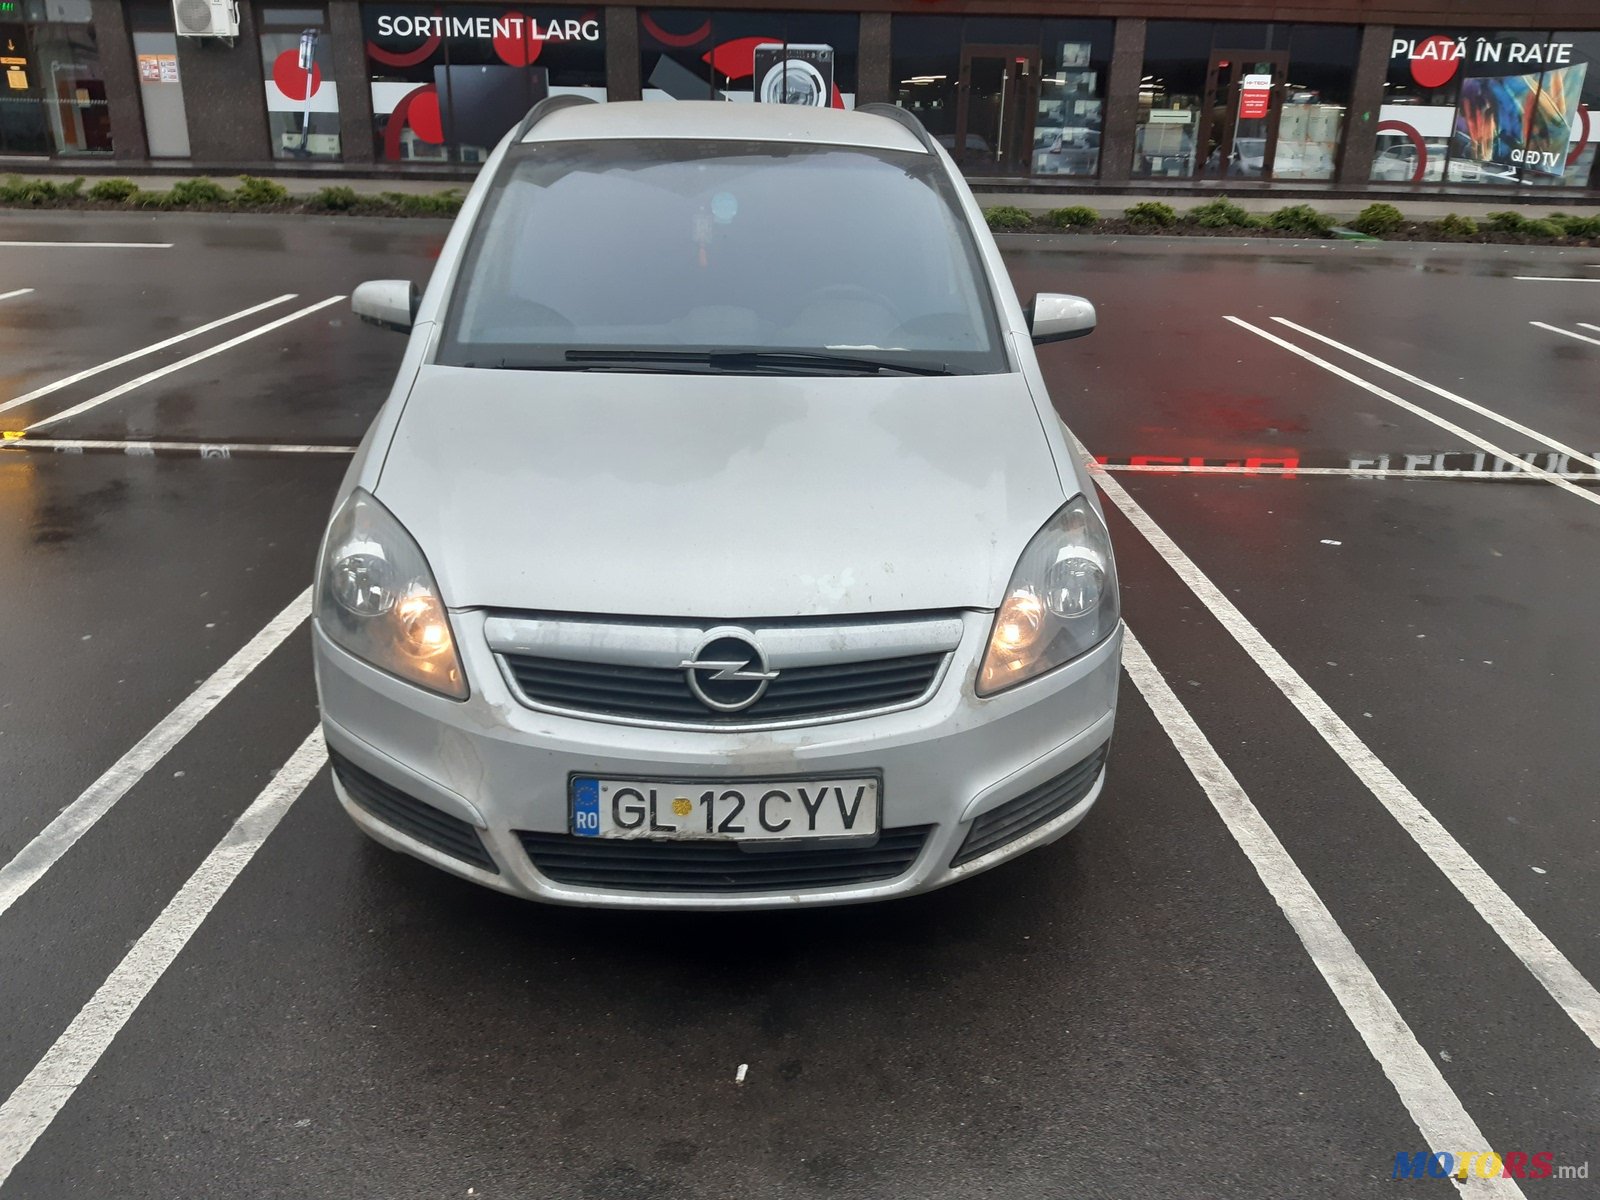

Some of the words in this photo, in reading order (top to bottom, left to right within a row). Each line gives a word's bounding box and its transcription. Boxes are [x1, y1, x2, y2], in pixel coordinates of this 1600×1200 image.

[378, 15, 524, 39] SORTIMENT
[531, 19, 600, 41] LARG
[1390, 36, 1468, 62] PLATĂ
[1475, 37, 1503, 63] ÎN
[1508, 42, 1573, 64] RATE
[1542, 151, 1561, 167] TV
[576, 811, 598, 829] RO
[611, 787, 678, 833] GL
[699, 789, 746, 834] 12
[757, 785, 866, 833] CYV
